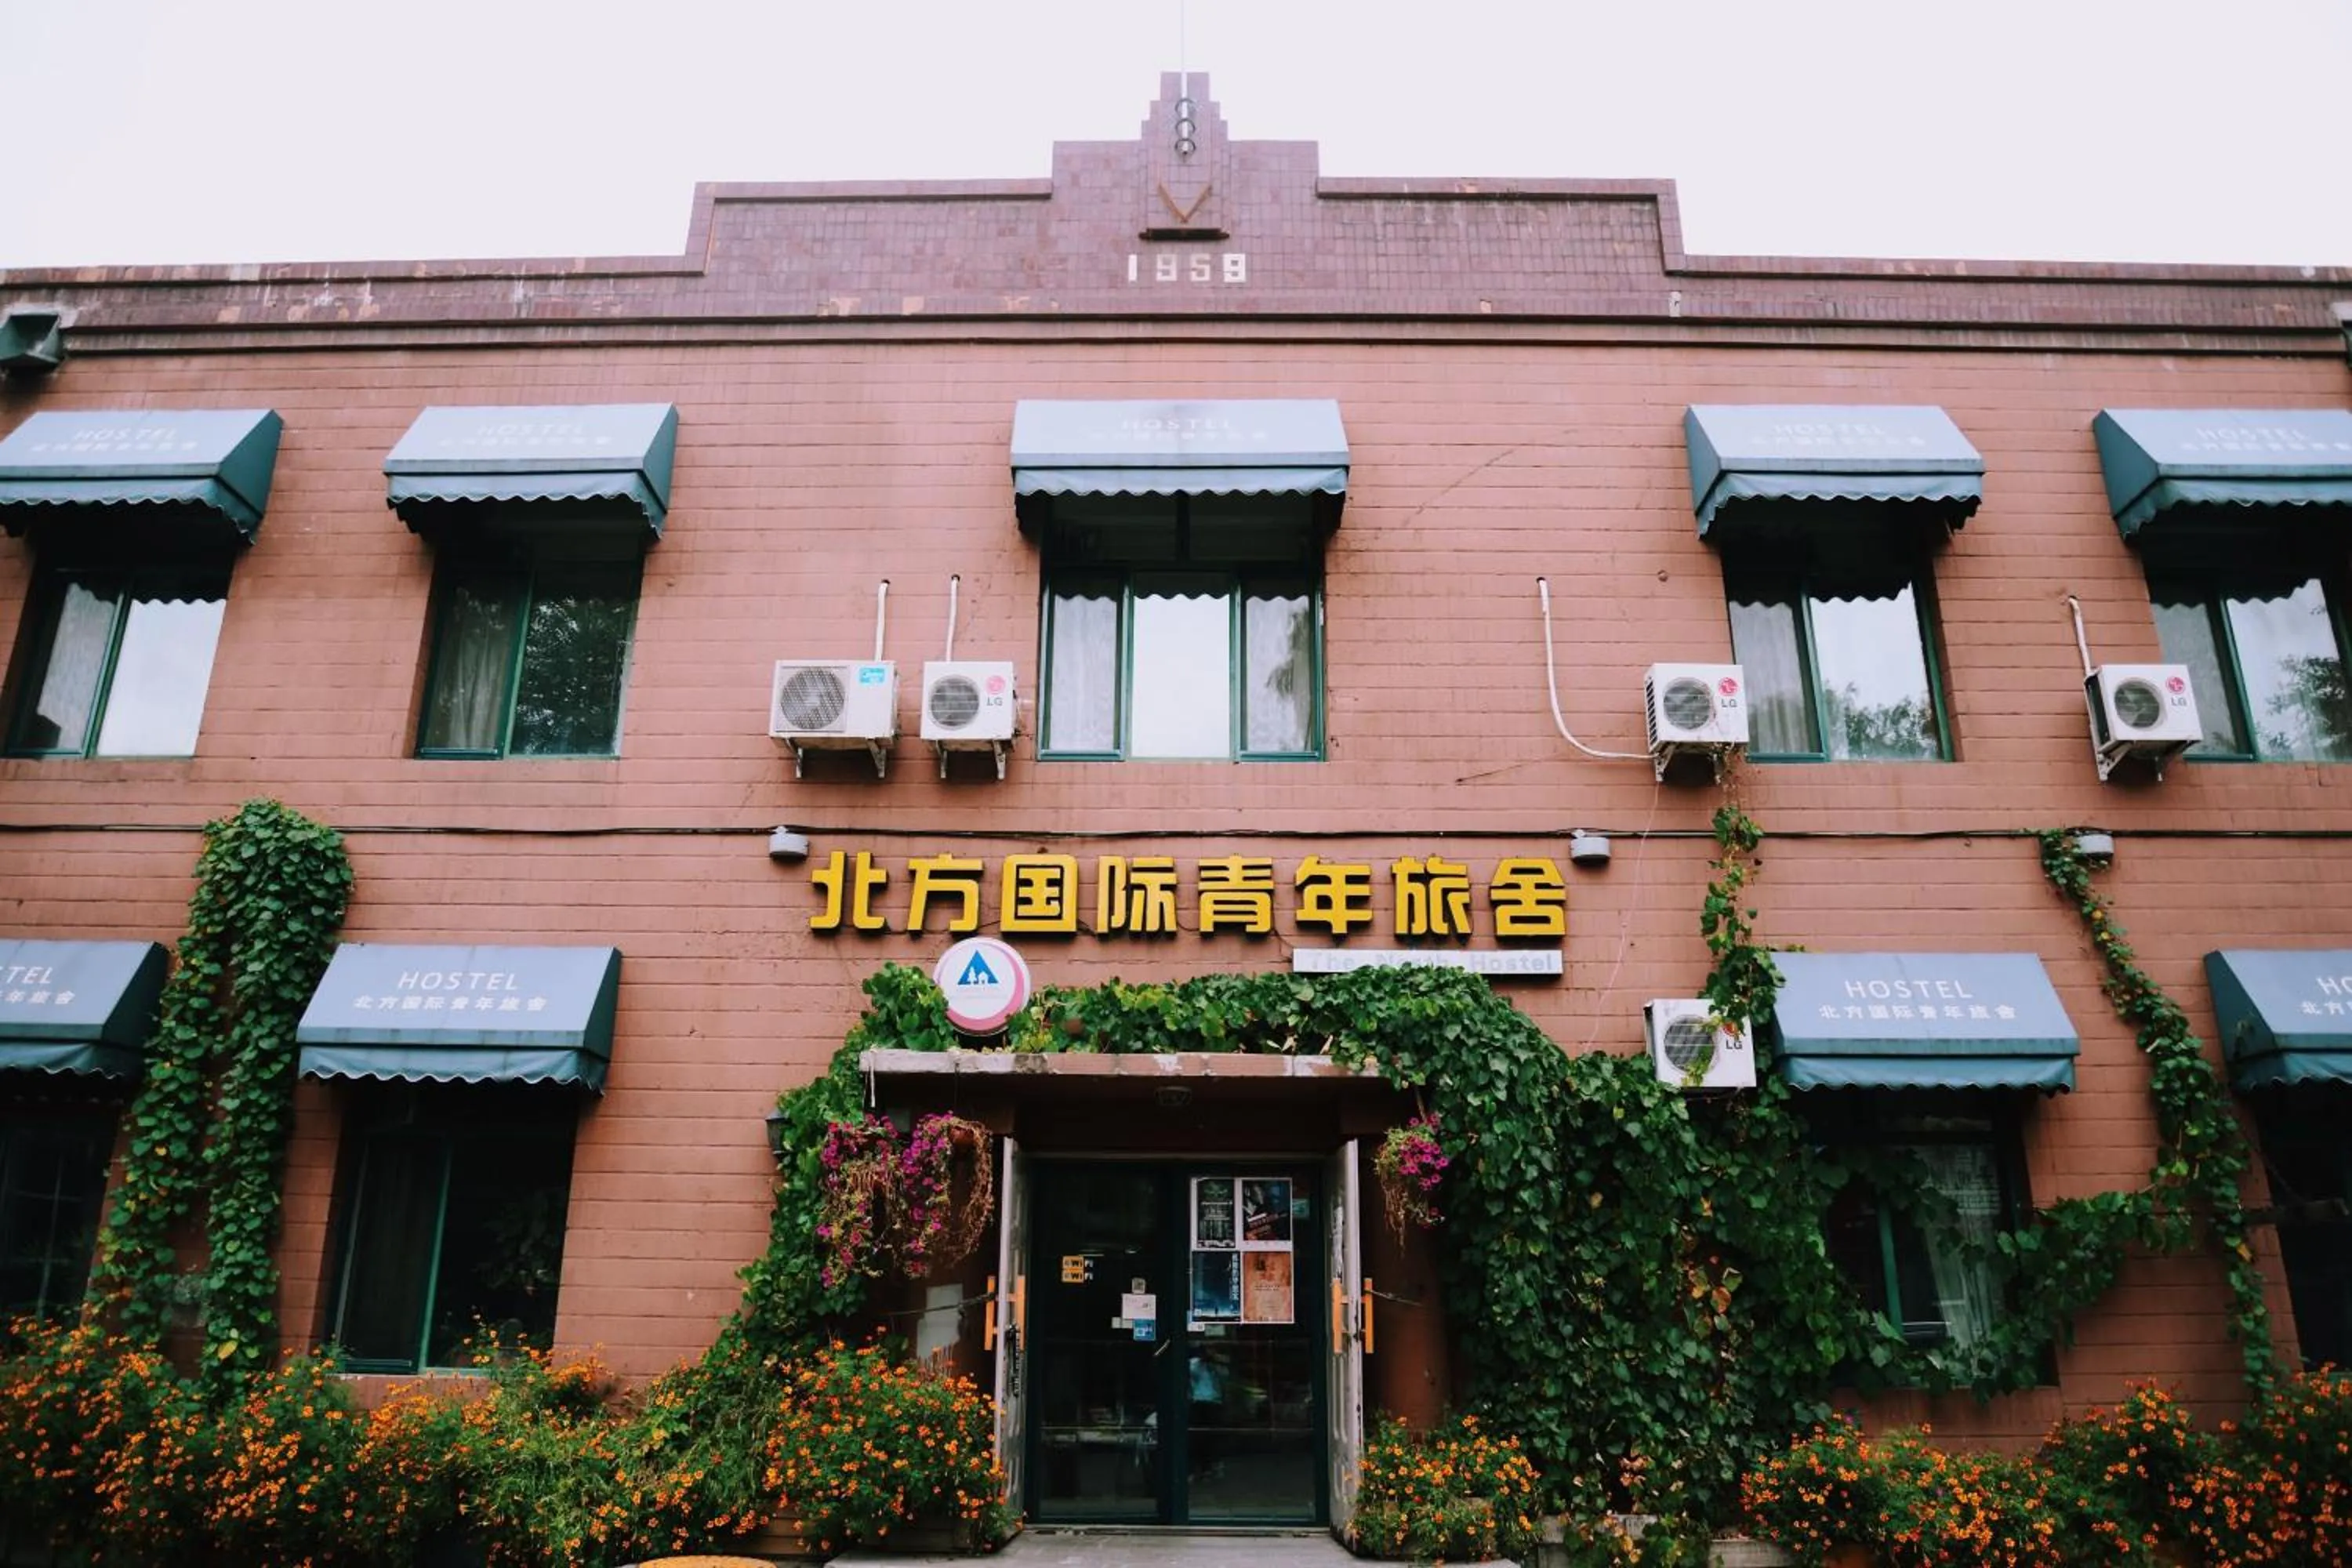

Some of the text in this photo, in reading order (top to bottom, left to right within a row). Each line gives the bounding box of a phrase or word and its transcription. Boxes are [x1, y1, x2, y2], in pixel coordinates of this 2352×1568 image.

[985, 697, 1004, 706] LG
[1721, 699, 1738, 708] LG
[2171, 697, 2187, 706] LG
[809, 851, 1566, 937] 北方国际青年旅舍
[1308, 953, 1355, 970] The
[1470, 953, 1553, 971] Hostel
[0, 966, 53, 984] TEL
[397, 971, 520, 990] HOSTEL
[1844, 980, 1975, 999] HOSTEL
[2302, 1001, 2352, 1015] 北方
[1726, 1040, 1743, 1050] LG
